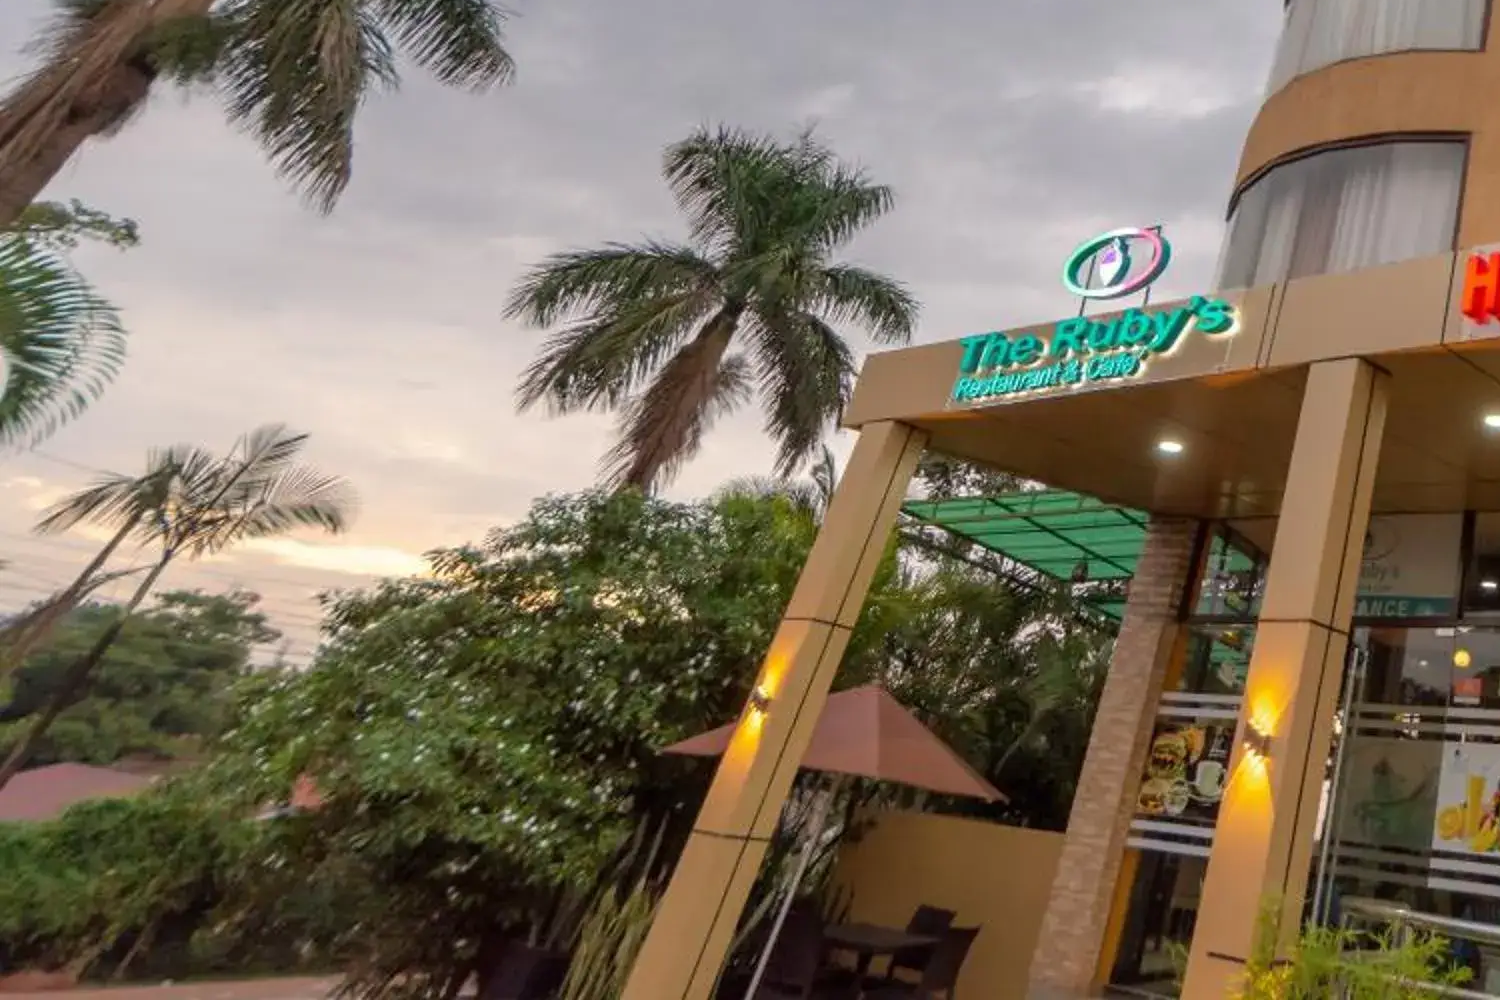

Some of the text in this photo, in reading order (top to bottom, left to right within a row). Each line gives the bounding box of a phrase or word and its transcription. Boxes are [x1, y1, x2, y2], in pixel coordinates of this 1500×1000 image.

[959, 295, 1236, 373] The Ruby's
[955, 366, 1061, 401] Restaurant
